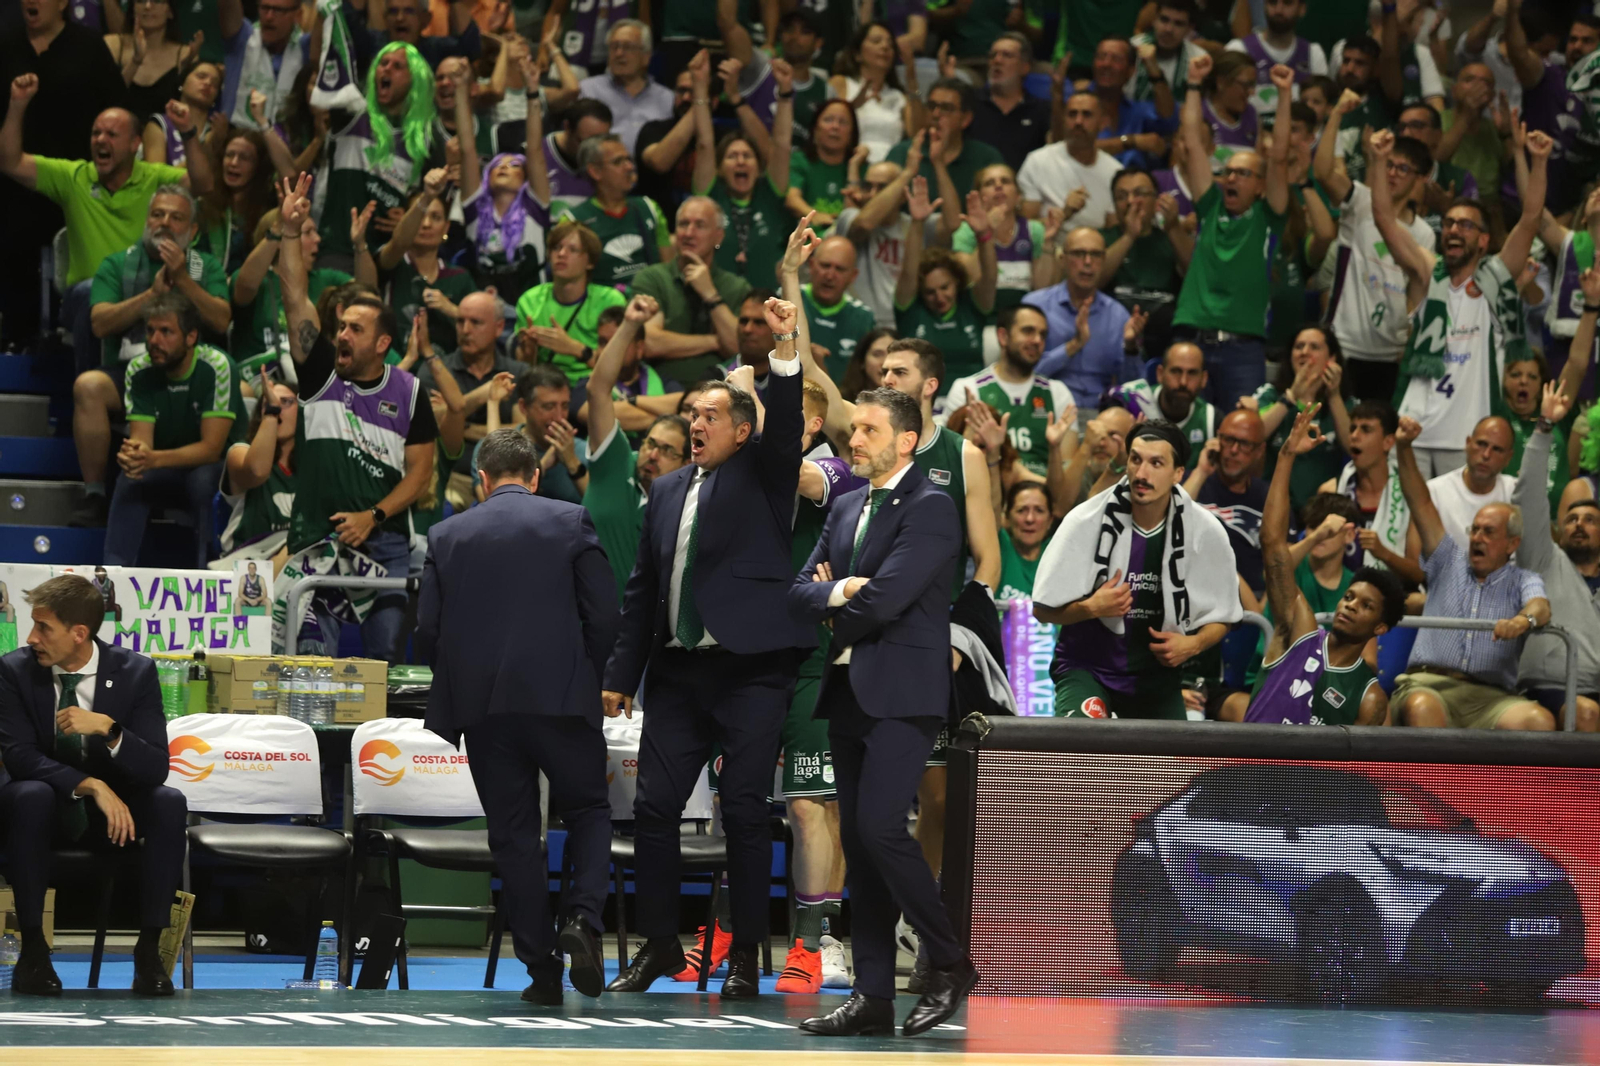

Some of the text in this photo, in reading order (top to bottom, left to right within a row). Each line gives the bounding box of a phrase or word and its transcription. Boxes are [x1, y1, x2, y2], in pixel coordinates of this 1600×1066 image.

[1436, 373, 1455, 399] 4
[1007, 426, 1032, 452] 16
[129, 576, 232, 615] VAMOS
[113, 613, 251, 653] MÁLAGA
[1027, 678, 1054, 717] VE
[224, 751, 311, 762] COSTA DEL SOL
[412, 755, 448, 765] COSTA
[798, 752, 820, 766] má
[224, 761, 274, 772] MÁLAGA
[413, 764, 460, 775] MÁLAGA
[793, 762, 821, 779] laga
